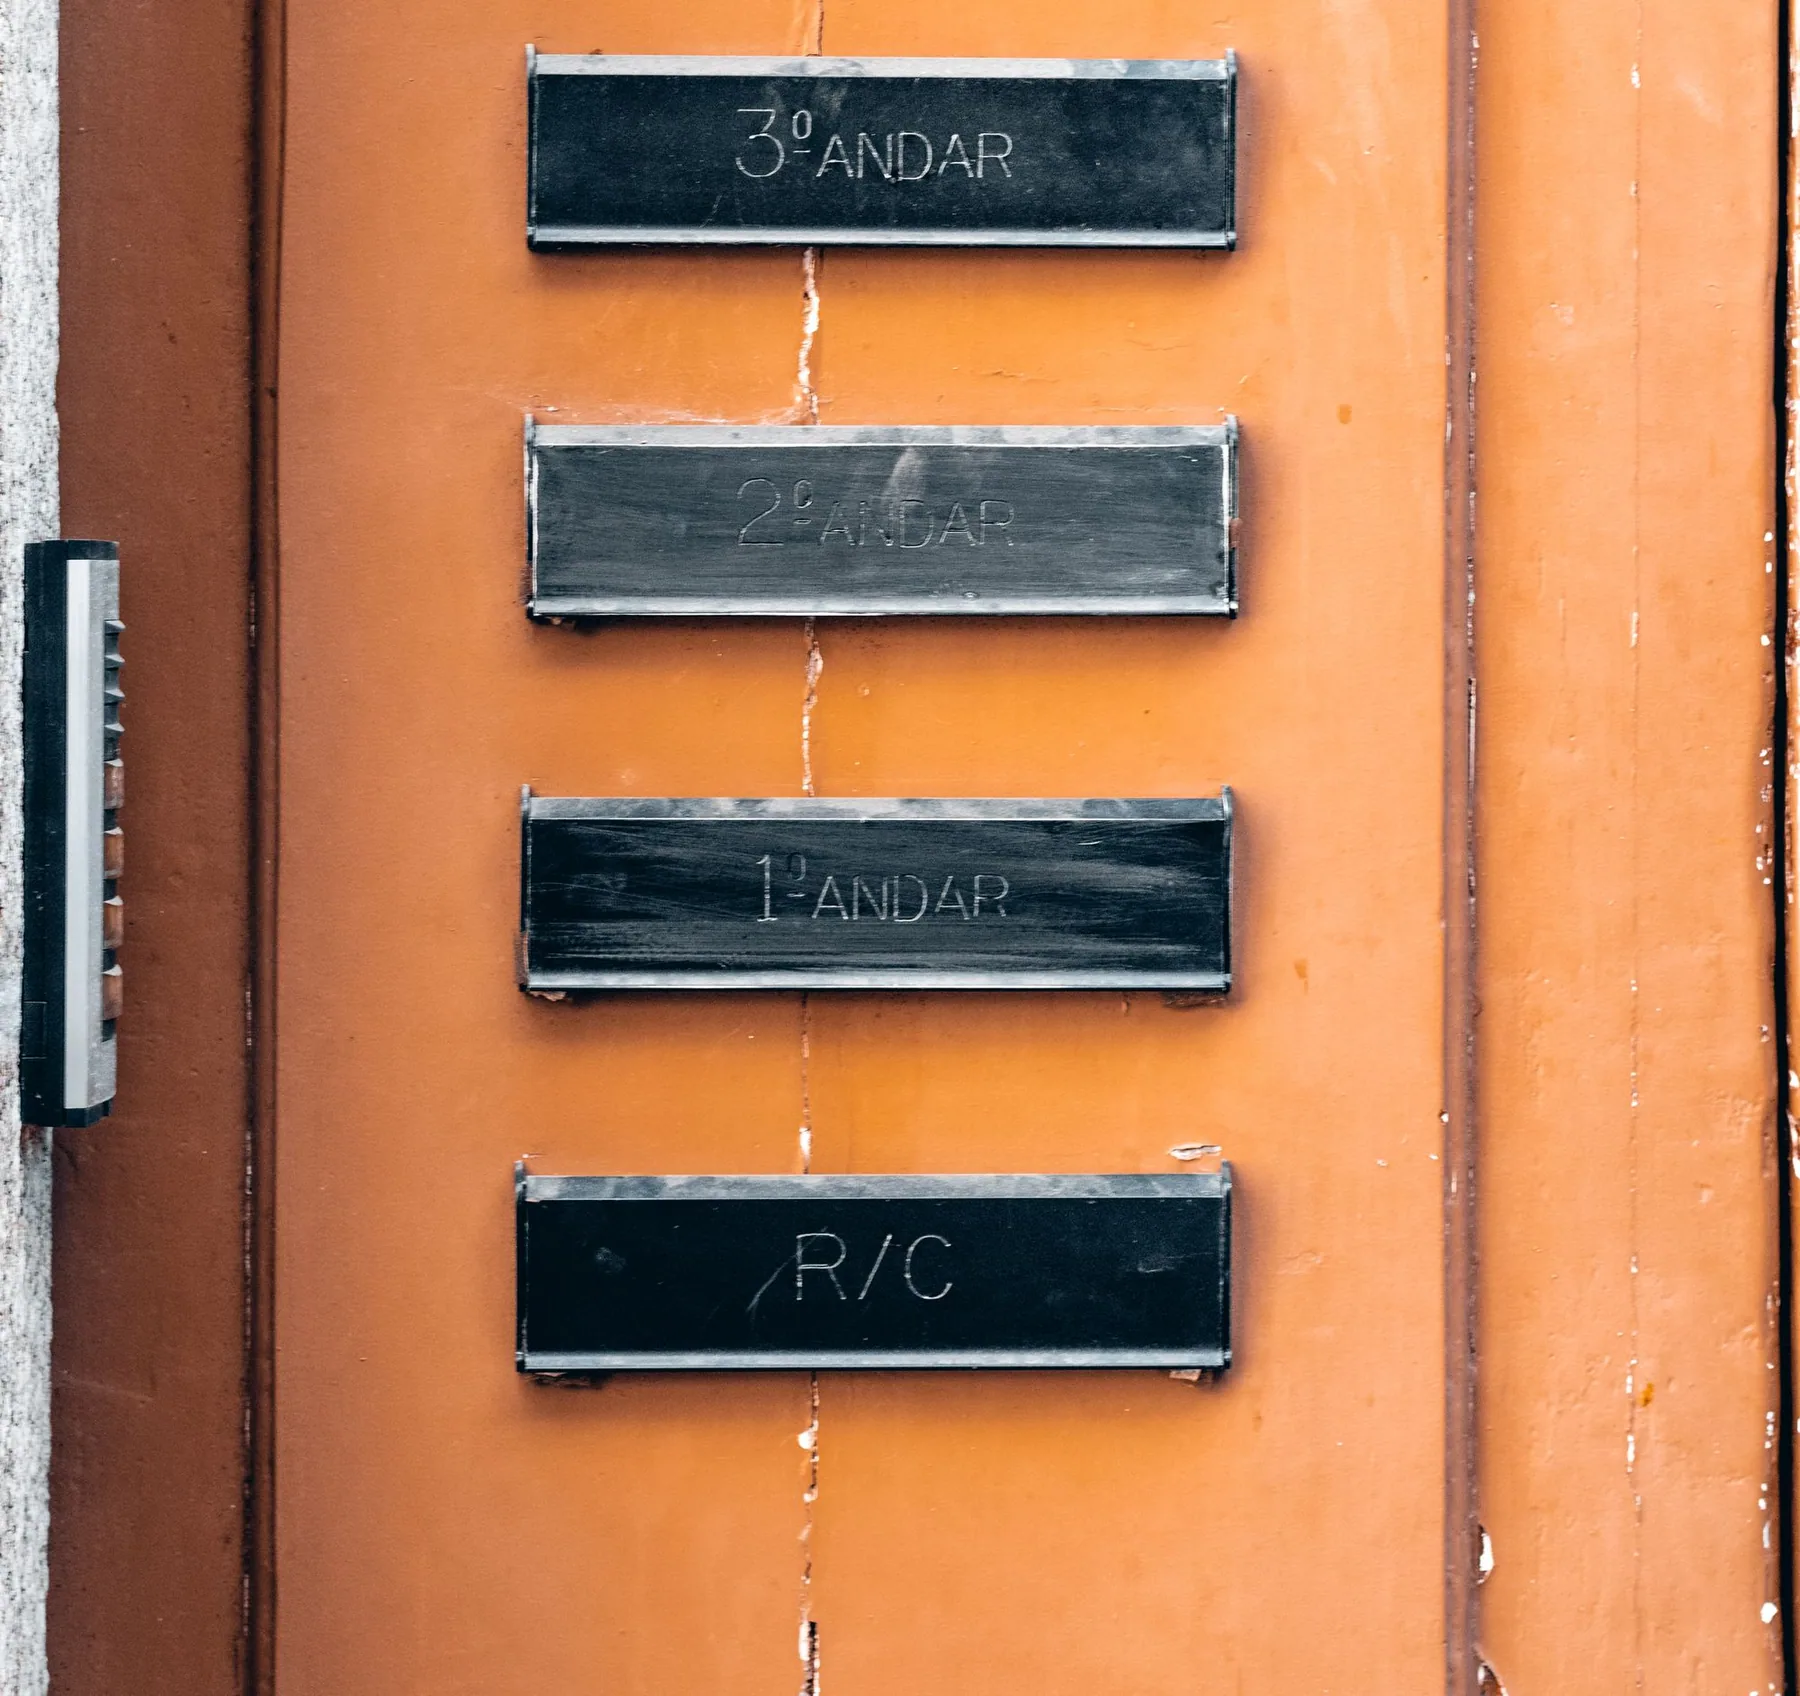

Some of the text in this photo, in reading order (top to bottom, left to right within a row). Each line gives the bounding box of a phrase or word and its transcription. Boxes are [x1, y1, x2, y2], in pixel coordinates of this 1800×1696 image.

[815, 132, 1013, 180] ANDAR
[819, 499, 1015, 549] ANDAR
[811, 874, 1009, 922] ANDAR
[796, 1232, 952, 1300] R/C
